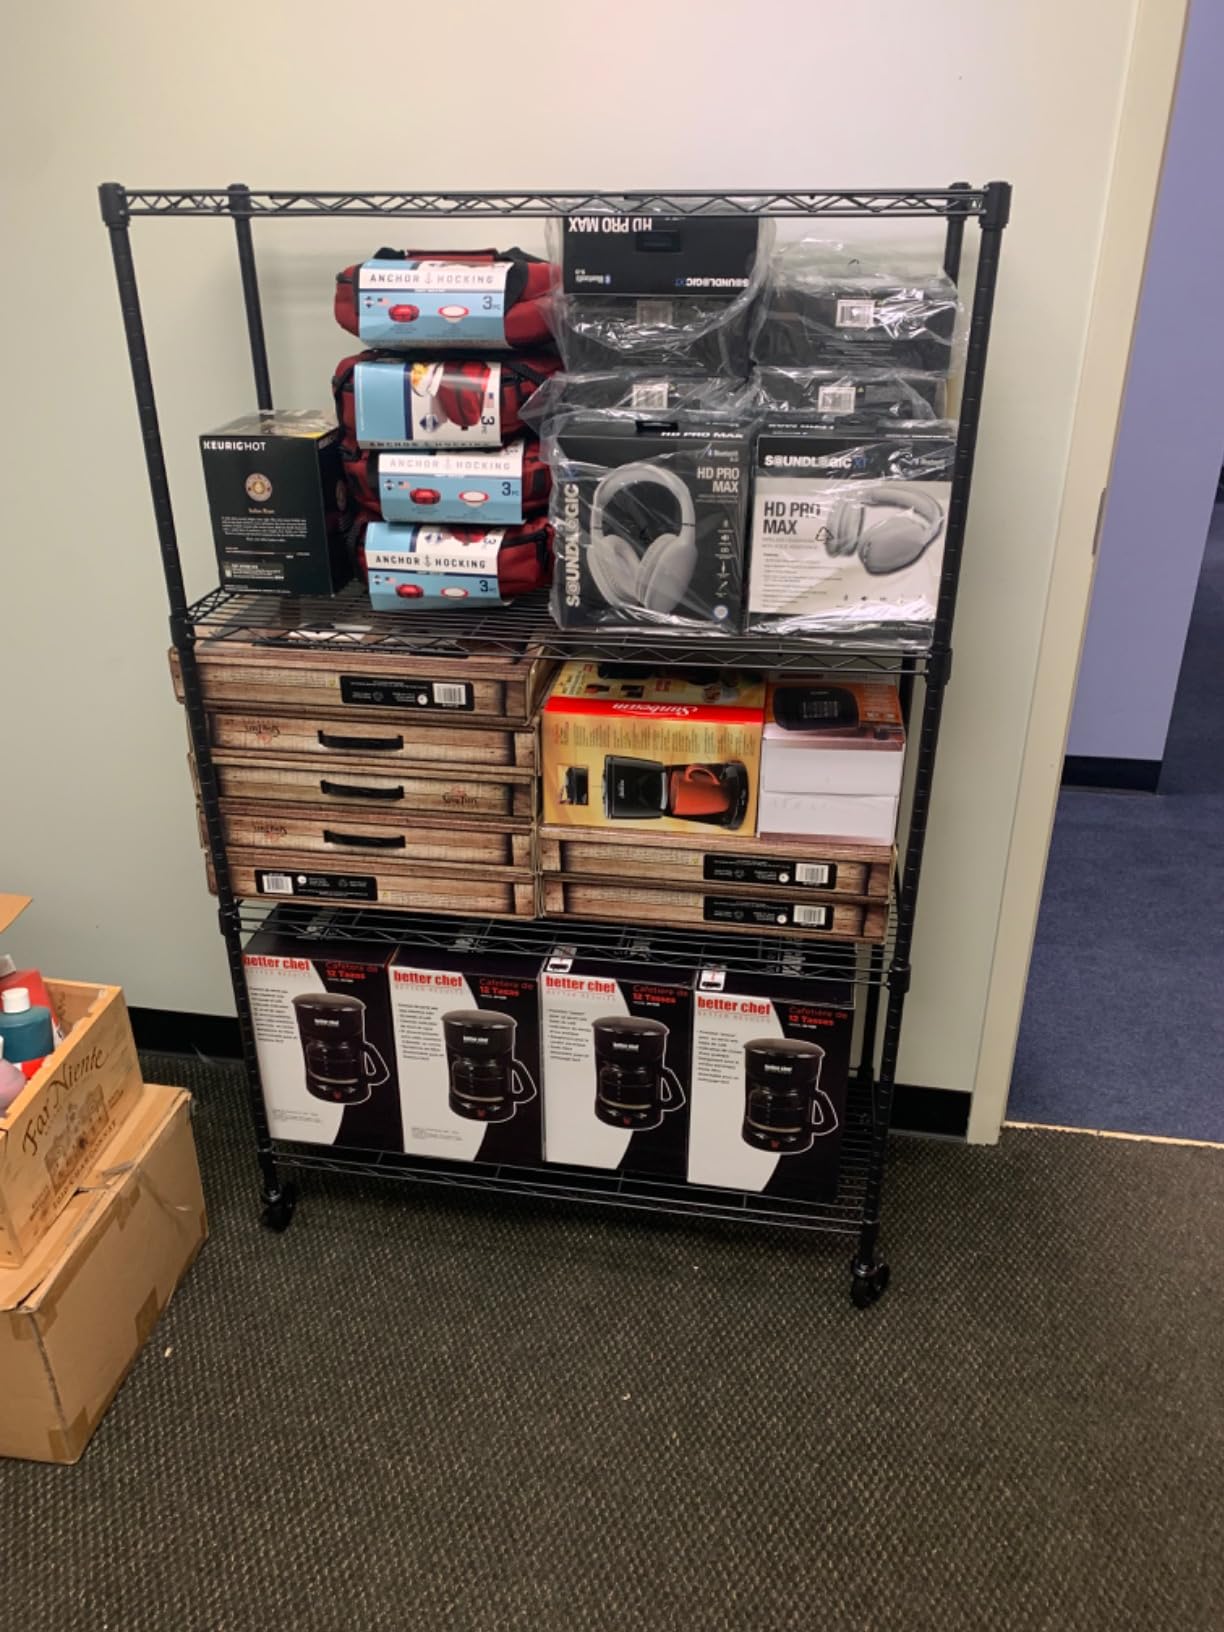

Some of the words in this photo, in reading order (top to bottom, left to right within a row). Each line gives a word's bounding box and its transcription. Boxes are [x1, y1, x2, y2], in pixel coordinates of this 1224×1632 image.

[568, 217, 599, 233] MAX
[602, 217, 630, 233] PRO
[370, 272, 420, 284] ANCHOR
[437, 272, 494, 285] HOCKING
[389, 458, 439, 468] ANCHOR
[456, 459, 511, 471] HOCKING
[697, 466, 714, 480] HD
[716, 466, 740, 481] PRO
[501, 481, 511, 497] 3
[712, 480, 739, 494] MAX
[764, 501, 786, 517] HD
[762, 518, 798, 536] MAX
[375, 555, 421, 566] ANCHOR
[435, 556, 487, 569] HOCKING
[479, 579, 489, 593] 3
[612, 702, 698, 717] Sunbeam
[283, 959, 311, 972] chef
[393, 970, 432, 985] better
[435, 974, 463, 987] chef
[545, 975, 584, 991] better
[588, 979, 616, 994] chef
[697, 995, 738, 1012] better
[741, 1001, 771, 1015] chef
[22, 1098, 50, 1157] Far
[47, 1046, 108, 1109] Niente
